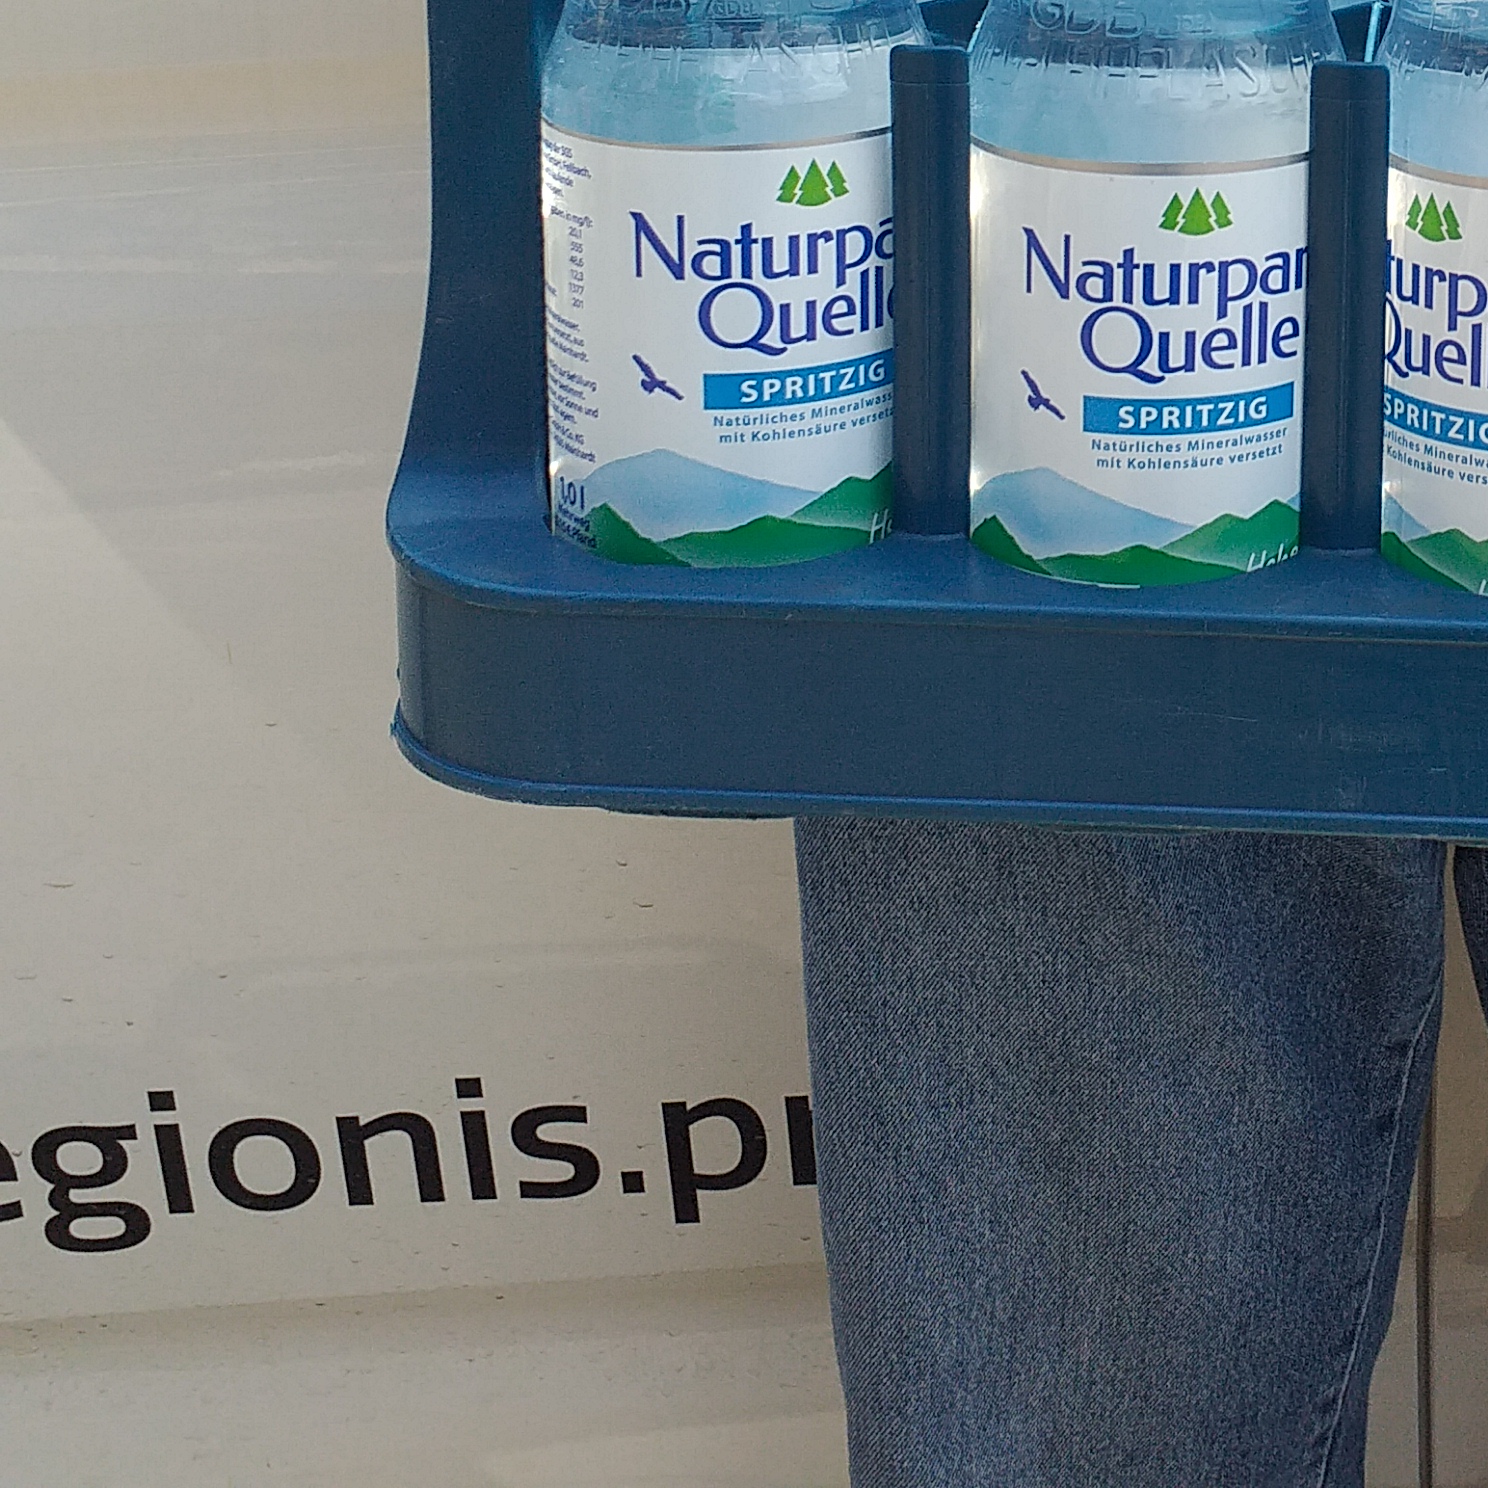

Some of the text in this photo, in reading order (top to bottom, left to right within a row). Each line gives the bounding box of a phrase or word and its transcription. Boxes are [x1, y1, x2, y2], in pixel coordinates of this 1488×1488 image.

[697, 266, 893, 356] Quell
[1080, 301, 1300, 383] Quelle
[740, 359, 885, 403] SPRITZIG
[713, 410, 805, 427] Natürliches
[1118, 396, 1268, 429] SPRITZIG
[719, 432, 746, 444] mit
[751, 421, 846, 442] Kohlensäure
[1091, 426, 1287, 454] Natürliches Mineralwasser
[1096, 443, 1283, 470] mit Kohlensäure versetzt
[1386, 444, 1455, 479] Kohlensäure
